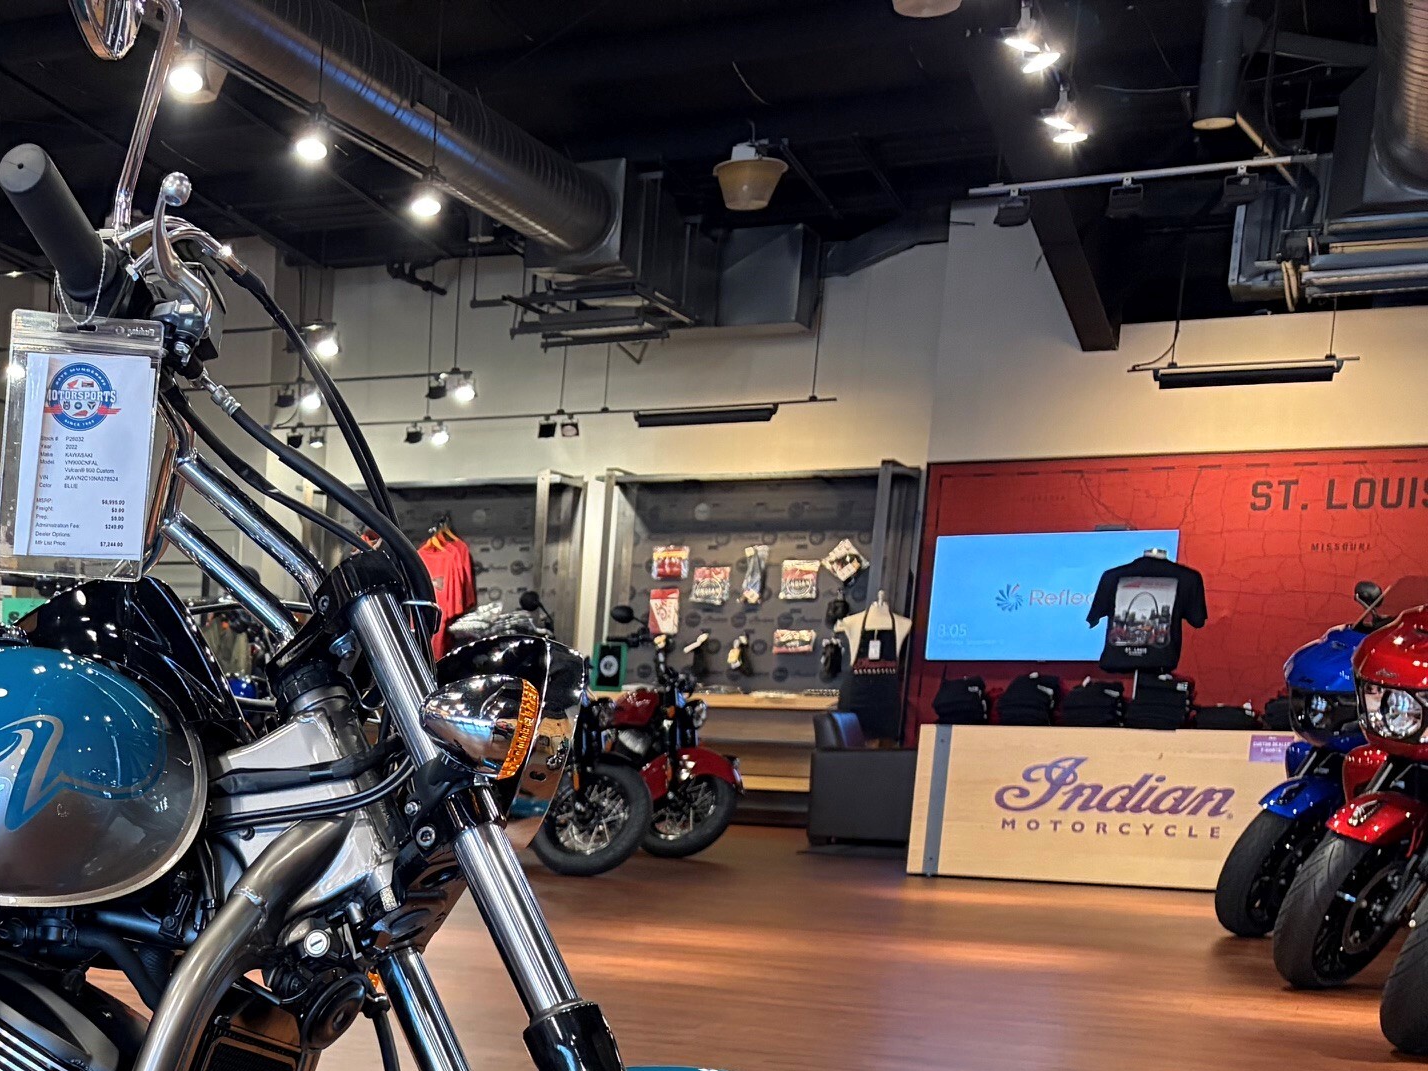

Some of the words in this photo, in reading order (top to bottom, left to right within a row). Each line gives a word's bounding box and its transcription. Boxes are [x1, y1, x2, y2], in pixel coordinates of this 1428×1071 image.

[1250, 478, 1309, 511] ST.
[1325, 476, 1428, 511] LOUI
[1310, 542, 1372, 552] MISSOURI
[994, 756, 1235, 818] Indian
[1001, 818, 1221, 839] MOTORCYCLE
